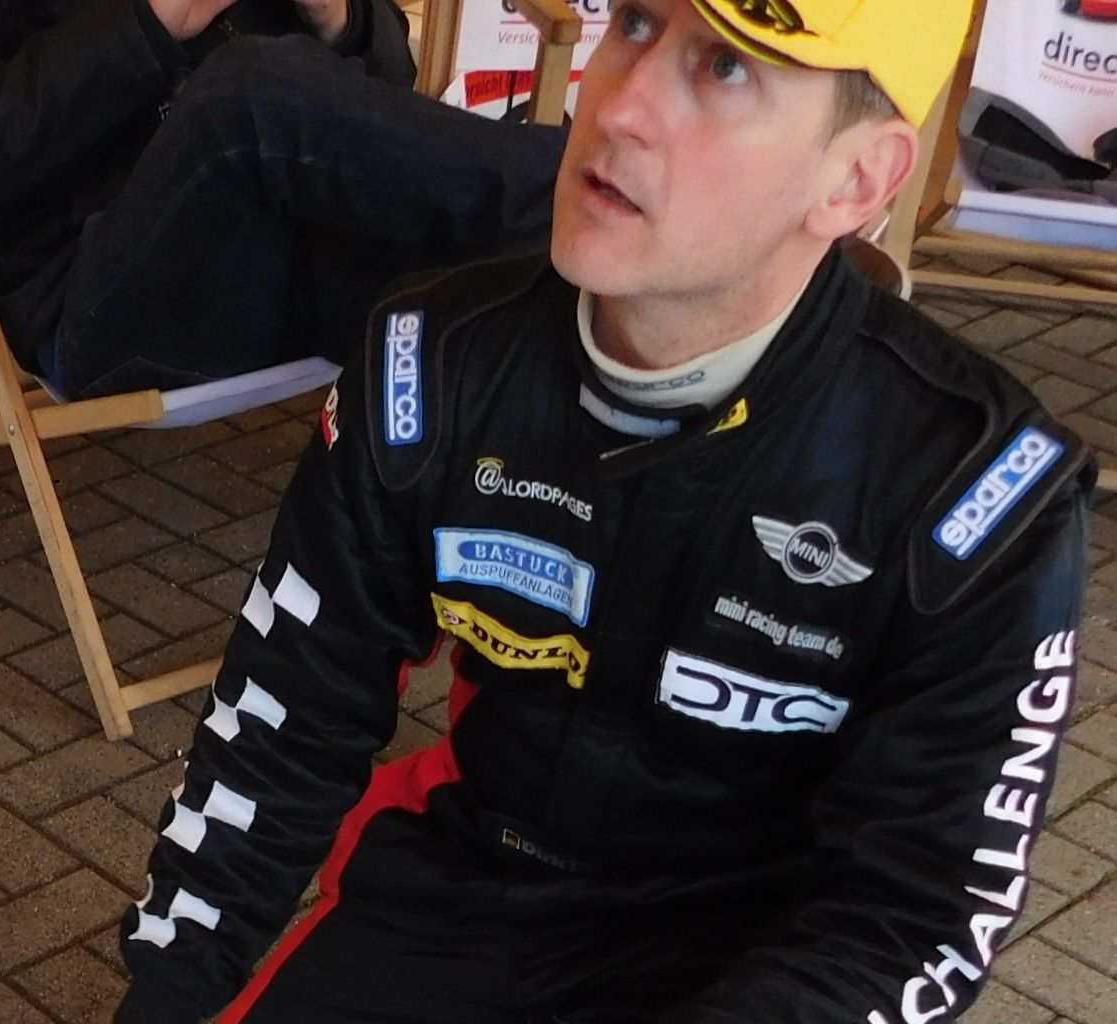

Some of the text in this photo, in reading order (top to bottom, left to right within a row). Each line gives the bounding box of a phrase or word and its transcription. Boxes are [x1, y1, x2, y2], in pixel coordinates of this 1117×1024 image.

[388, 315, 419, 440] sparco
[940, 432, 1050, 548] sparco
[474, 543, 569, 584] BASTUCK
[789, 537, 830, 569] MINI
[470, 621, 582, 673] DUNLO
[714, 596, 749, 622] mini
[745, 608, 788, 646] racing
[787, 625, 826, 651] team
[670, 665, 838, 729] DTC
